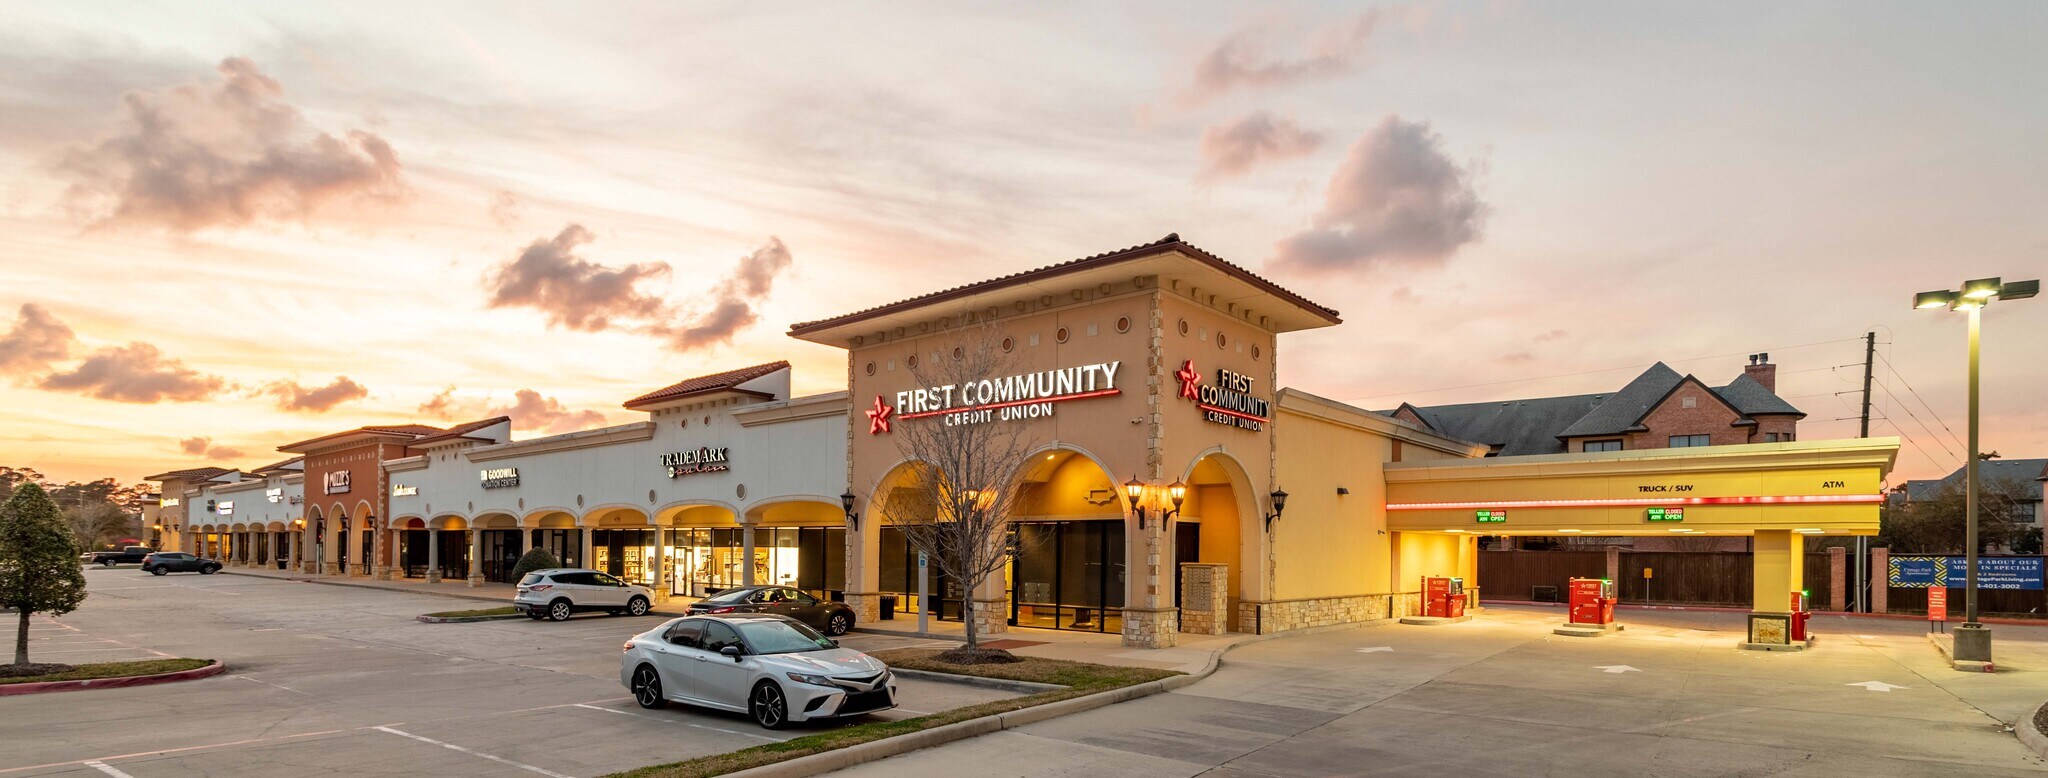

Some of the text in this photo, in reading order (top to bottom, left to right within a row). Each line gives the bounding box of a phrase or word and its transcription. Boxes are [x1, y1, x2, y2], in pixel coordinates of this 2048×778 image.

[897, 360, 1121, 414] FIRST COMMUNITY
[1222, 369, 1254, 394] FIRST
[1201, 384, 1271, 418] COMMUNITY
[945, 403, 1052, 427] CREDIT UNION
[1208, 411, 1263, 432] CREDIT UNION
[661, 447, 726, 466] TRADEMARK
[488, 468, 517, 480] GOODWILL
[1638, 485, 1667, 493] TRUCK
[1675, 484, 1694, 492] SUV
[1822, 481, 1845, 489] ATM
